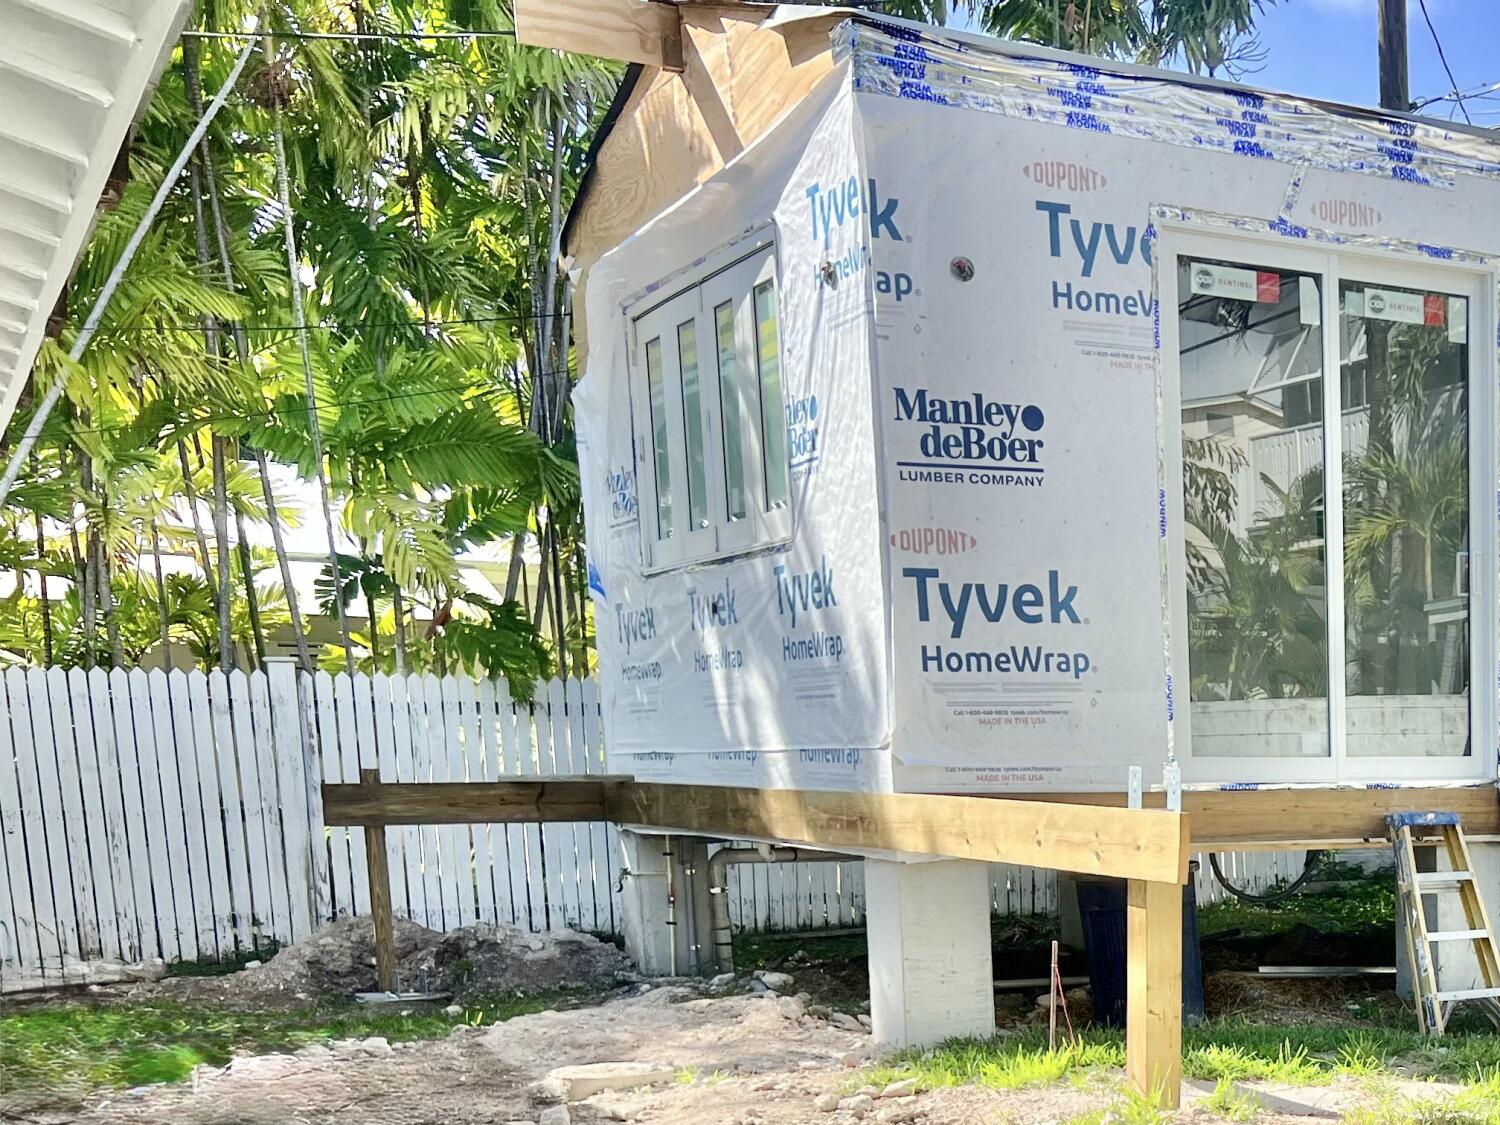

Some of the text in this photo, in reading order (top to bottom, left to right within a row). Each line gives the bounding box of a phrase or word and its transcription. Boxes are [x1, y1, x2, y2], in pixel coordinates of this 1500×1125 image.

[1047, 87, 1092, 102] WINDOW
[1215, 117, 1256, 131] WINDOW
[1033, 162, 1099, 192] DUPONT
[806, 175, 904, 251] Tyvek
[1319, 200, 1375, 228] DUPONT
[893, 387, 1023, 440] Manley
[920, 425, 1045, 463] deBoer
[899, 470, 1045, 488] LUMBER COMPANY
[900, 528, 967, 555] DUPONT
[774, 554, 837, 629] Tyvek
[902, 567, 1082, 639] Tyvek
[687, 577, 738, 640] Tyvek
[615, 598, 657, 655] Tyvek
[694, 648, 743, 673] HomeWrap
[782, 632, 843, 663] HomeWrap
[920, 645, 1090, 680] HomeWrap
[621, 660, 663, 681] HomeWrap
[978, 717, 1047, 725] MADE IN THE USA
[976, 774, 1044, 782] MADE IN THE USA
